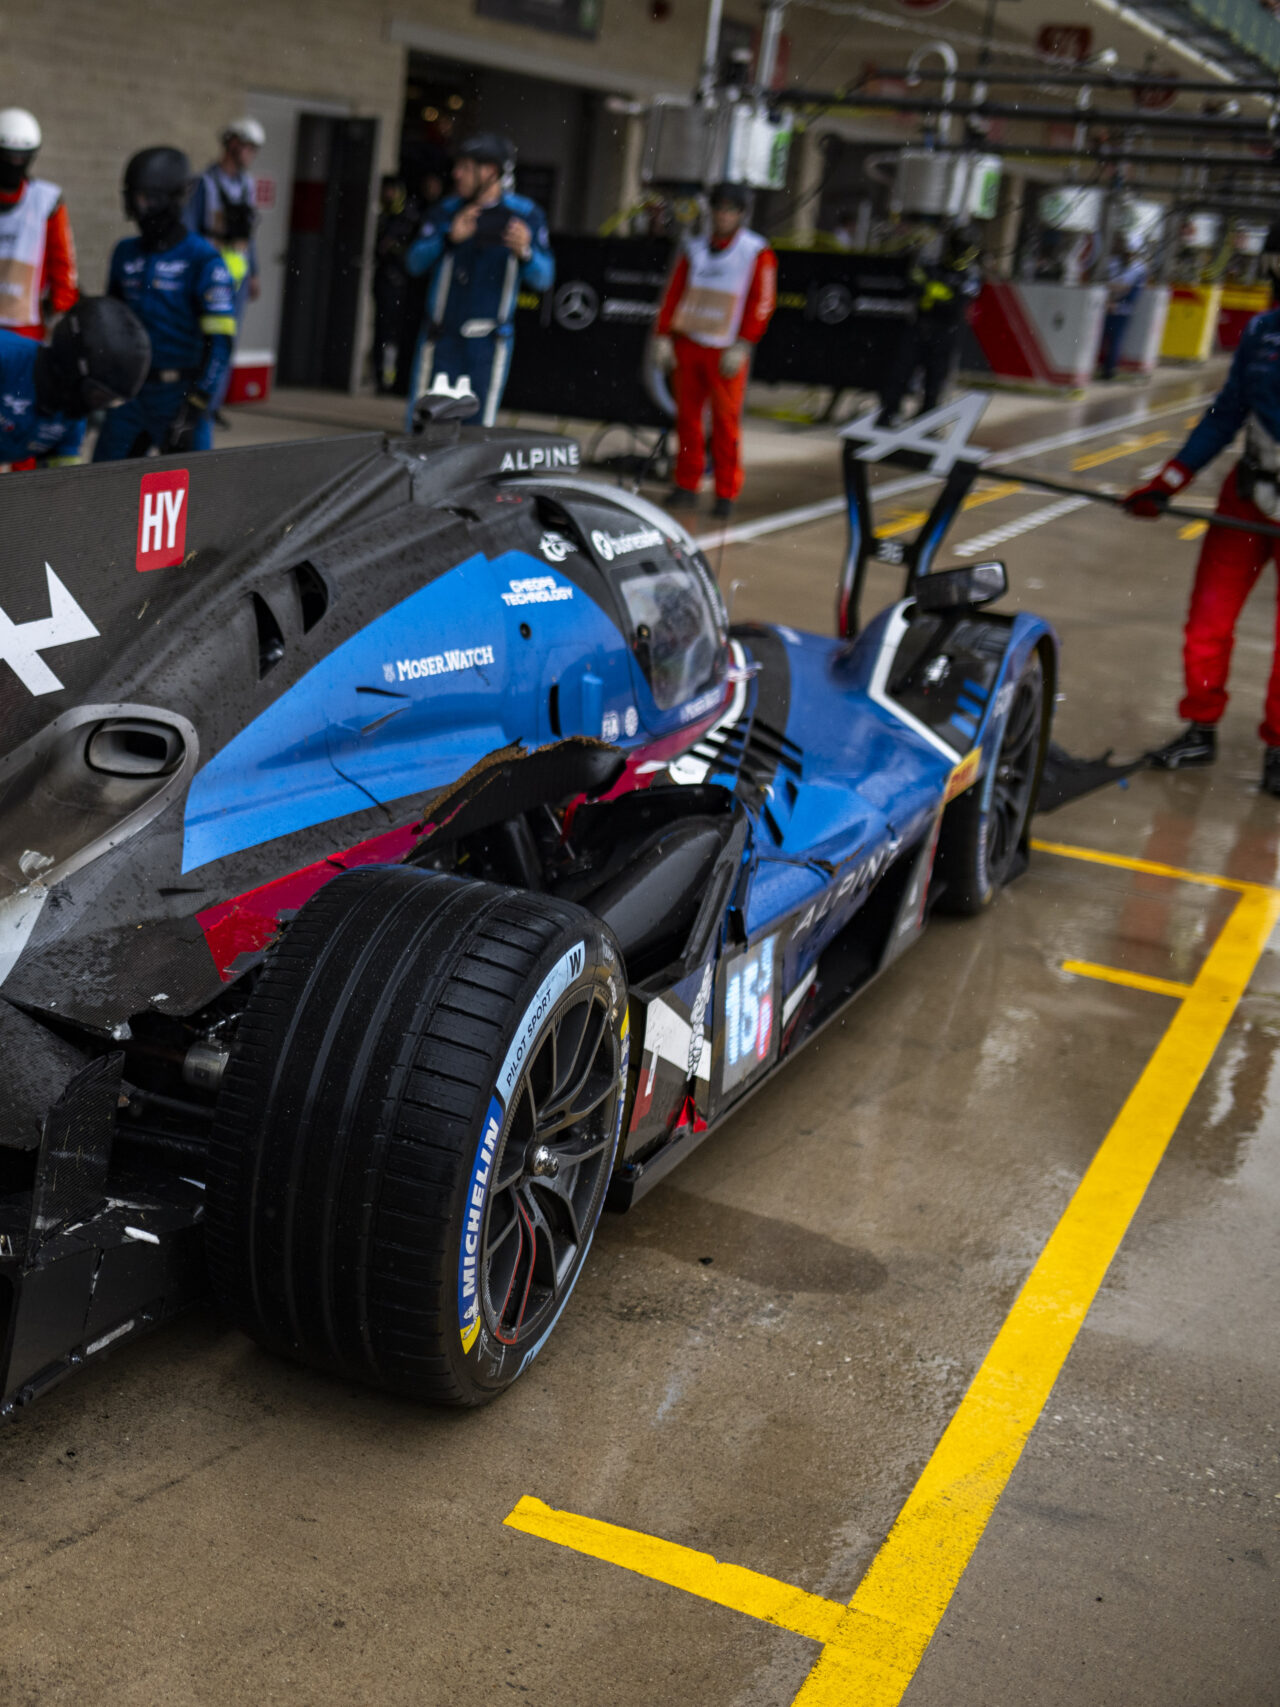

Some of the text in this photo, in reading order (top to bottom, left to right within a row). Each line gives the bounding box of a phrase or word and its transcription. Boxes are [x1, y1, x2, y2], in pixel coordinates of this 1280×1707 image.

[500, 443, 580, 472] ALPINE
[140, 488, 186, 553] HY
[500, 585, 573, 607] TECHNOLOGY
[396, 645, 495, 681] MOSER.WATCH
[570, 947, 582, 979] W
[506, 988, 553, 1087] PILOT SPORT
[462, 1116, 501, 1298] MICHELIN
